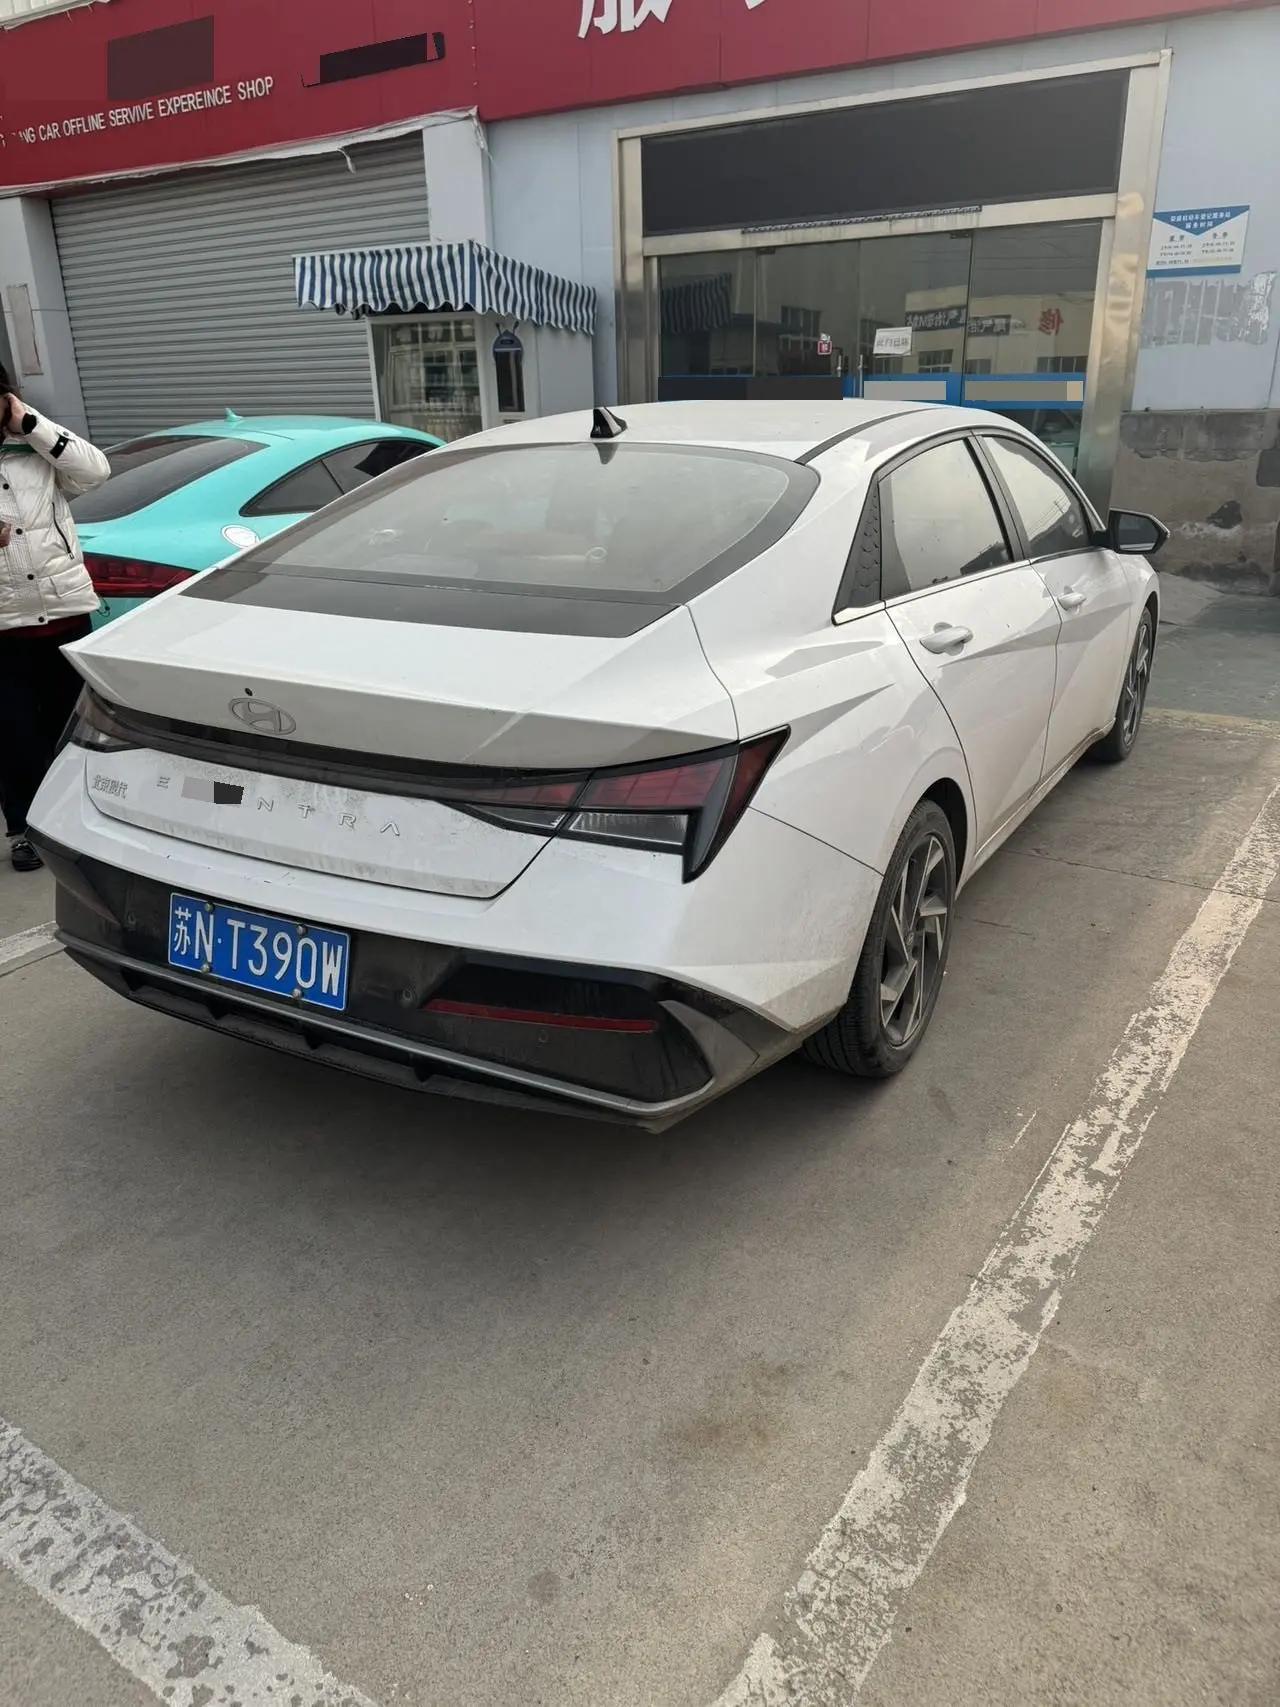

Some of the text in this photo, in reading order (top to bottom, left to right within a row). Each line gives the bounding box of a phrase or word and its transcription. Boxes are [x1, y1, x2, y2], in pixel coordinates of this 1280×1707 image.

[38, 122, 61, 142] CAR
[63, 112, 106, 137] OFFLINE
[109, 103, 154, 127] SERVIVE
[158, 84, 232, 117] EXPEREINCE
[237, 75, 274, 99] SHOP
[92, 775, 128, 799] 北京现代
[156, 776, 401, 836] ENTRA
